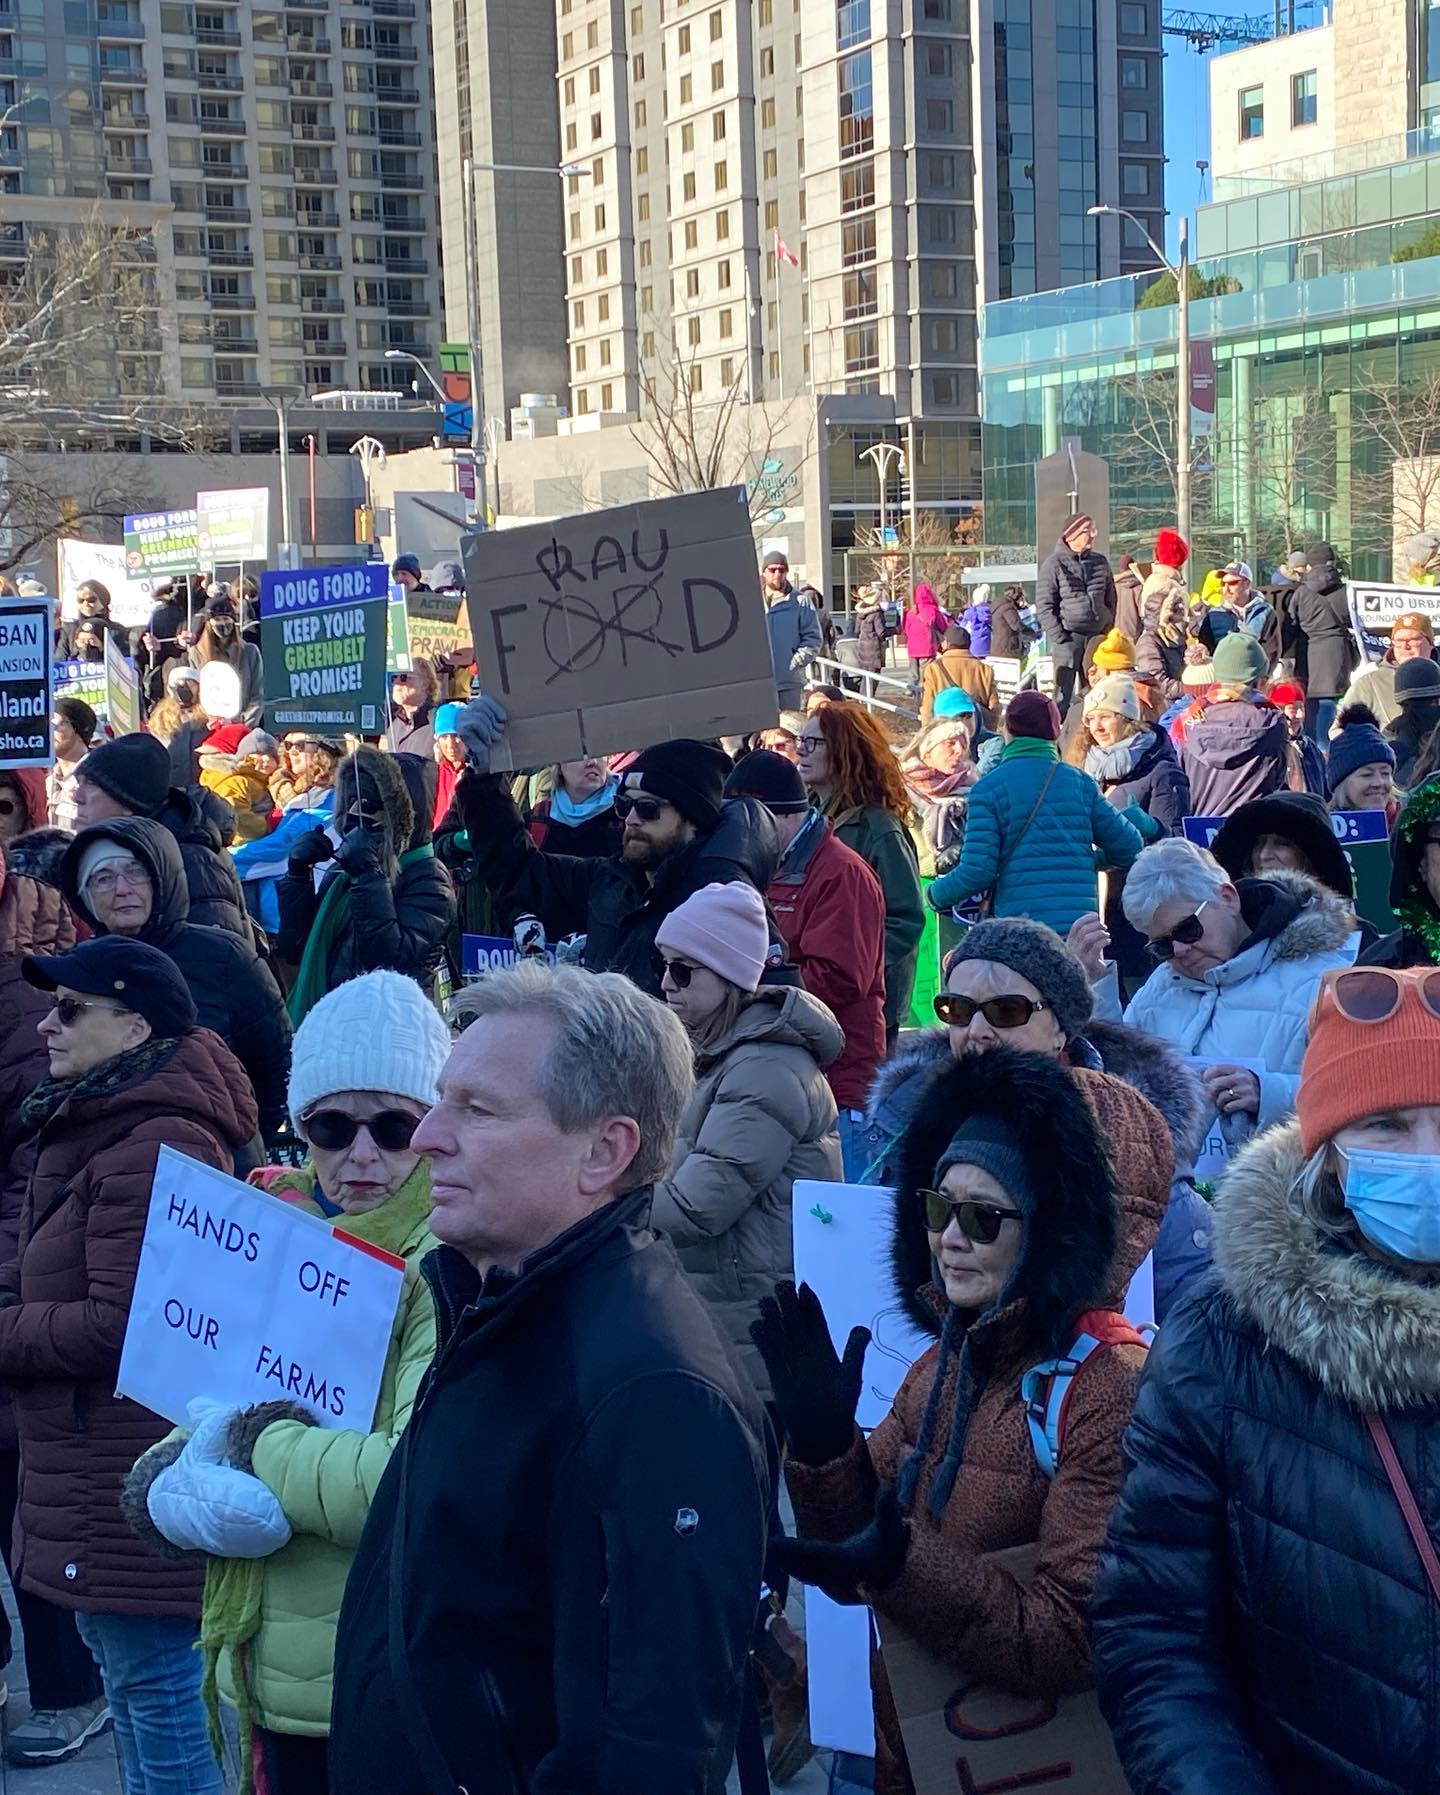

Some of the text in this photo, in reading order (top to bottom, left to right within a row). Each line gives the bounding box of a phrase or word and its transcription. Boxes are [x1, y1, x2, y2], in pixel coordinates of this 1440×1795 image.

[133, 515, 165, 531] DOUG
[140, 525, 198, 544] KEEP YOUR
[141, 536, 198, 554] GREENBELT
[274, 571, 371, 609] DOUG FORD:
[1384, 597, 1404, 608] NO
[283, 609, 365, 645] KEEP YOUR
[285, 636, 366, 671] GREENBELT
[290, 663, 362, 698] PROMISE!
[0, 689, 45, 718] land
[167, 1193, 351, 1307] HANDS OFF
[164, 1298, 346, 1416] OUR FARMS
